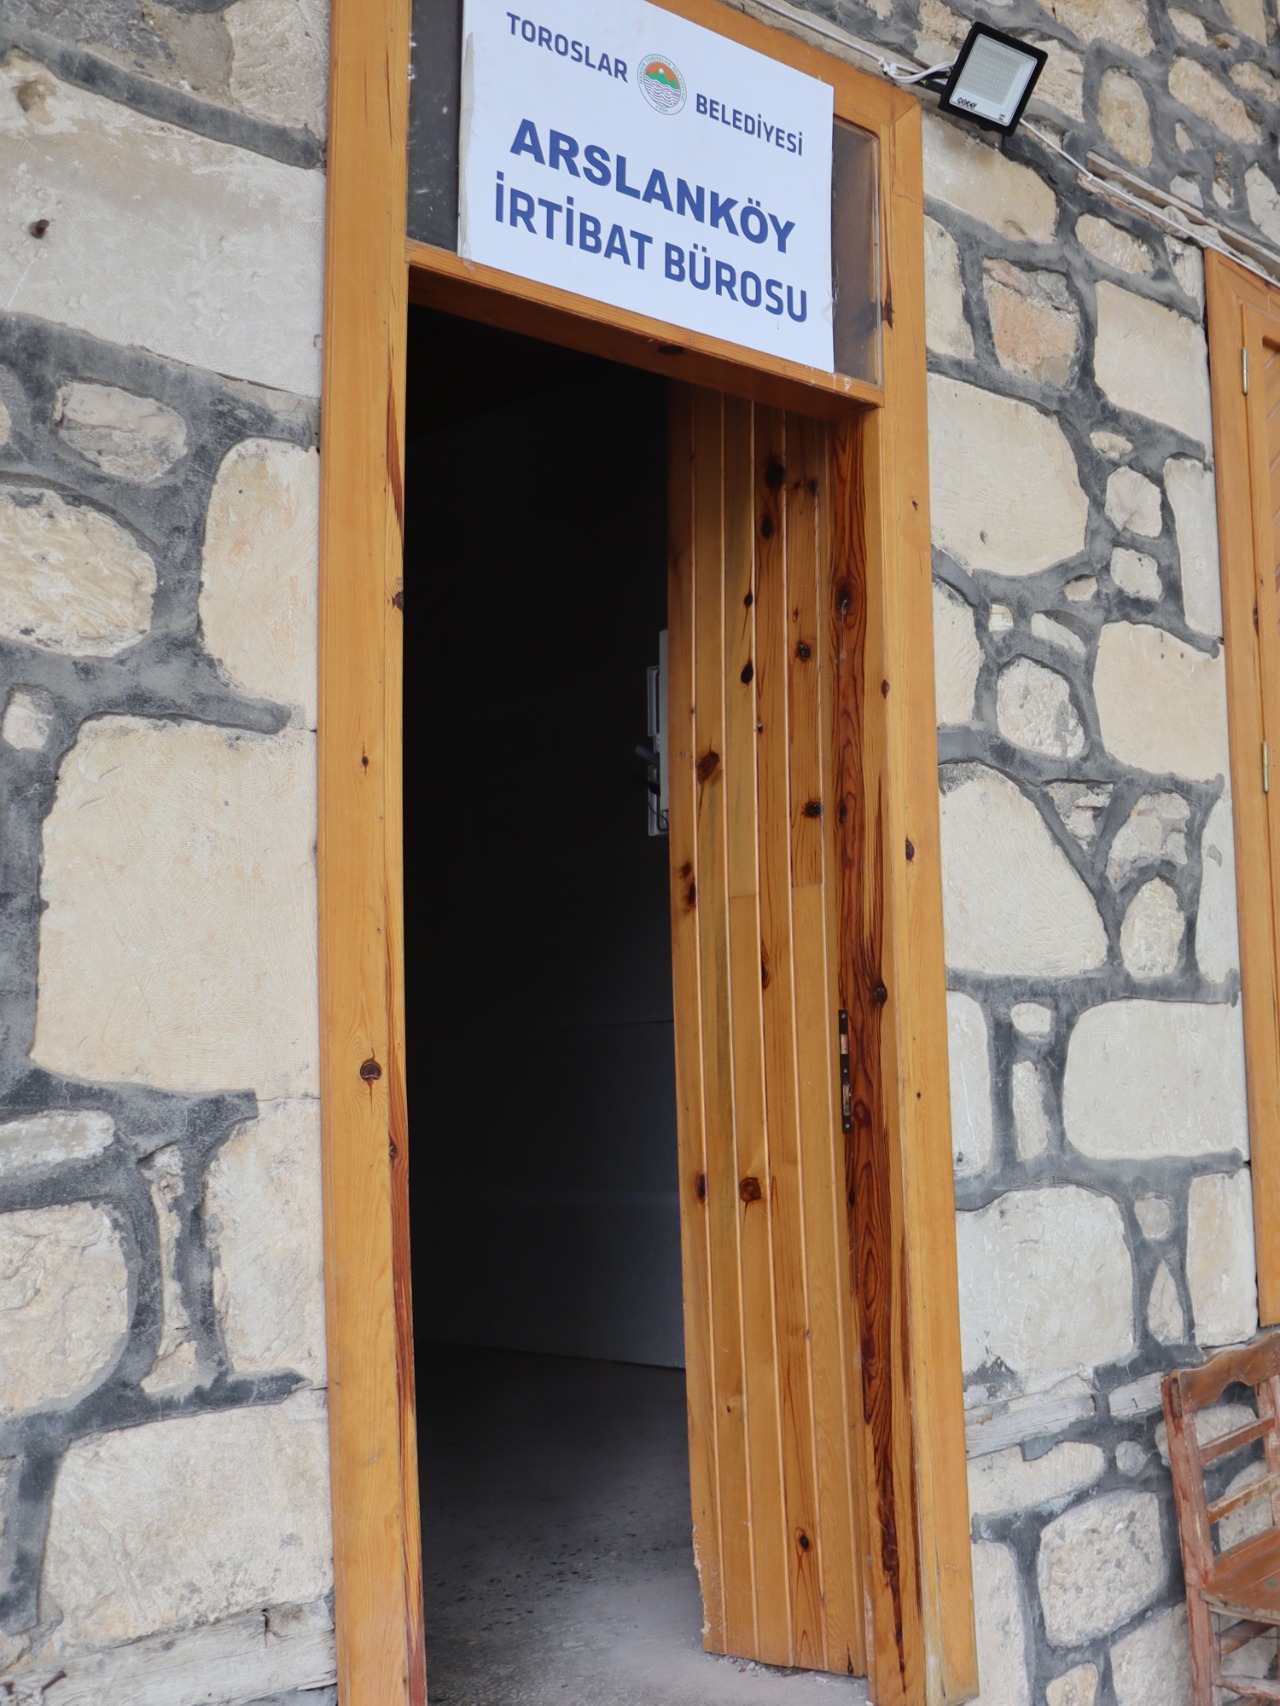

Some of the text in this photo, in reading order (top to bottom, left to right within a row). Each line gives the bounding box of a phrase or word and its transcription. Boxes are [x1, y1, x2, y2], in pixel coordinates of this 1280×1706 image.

[506, 11, 803, 156] TOROSLAR BELEDİYESİ
[495, 170, 808, 323] İRTİBAT BÜROSU
[509, 118, 796, 254] ARSLANKÖY
